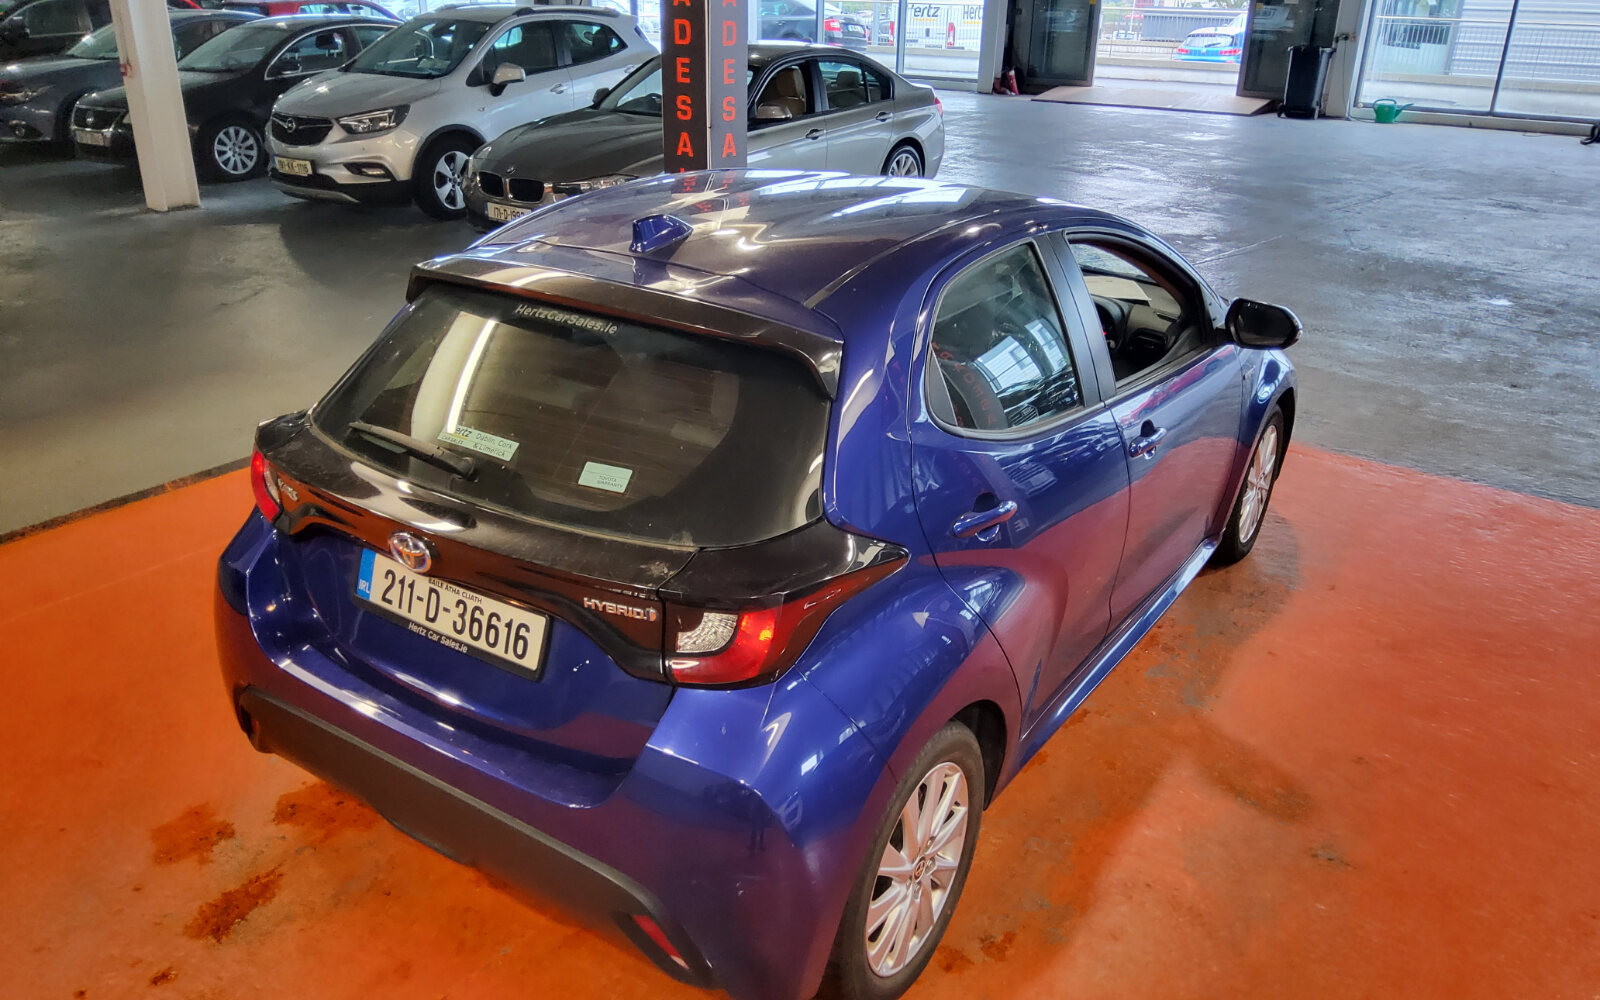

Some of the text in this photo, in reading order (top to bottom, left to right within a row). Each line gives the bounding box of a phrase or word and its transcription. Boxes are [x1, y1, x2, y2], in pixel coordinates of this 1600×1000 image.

[911, 4, 940, 18] ertz
[963, 5, 983, 20] Hert
[673, 0, 694, 172] DESA
[722, 0, 737, 158] DESA
[515, 304, 618, 334] HertzCarSales.ie
[454, 427, 472, 438] ertz
[479, 443, 506, 457] Limerick
[498, 440, 512, 450] Cork
[358, 578, 370, 594] IRL
[428, 578, 444, 589] BAILE
[462, 591, 482, 604] CLIATH
[381, 569, 530, 660] 211-D-36616
[583, 597, 647, 620] HYBRID
[408, 621, 468, 653] Hertz Car Sales.ie
